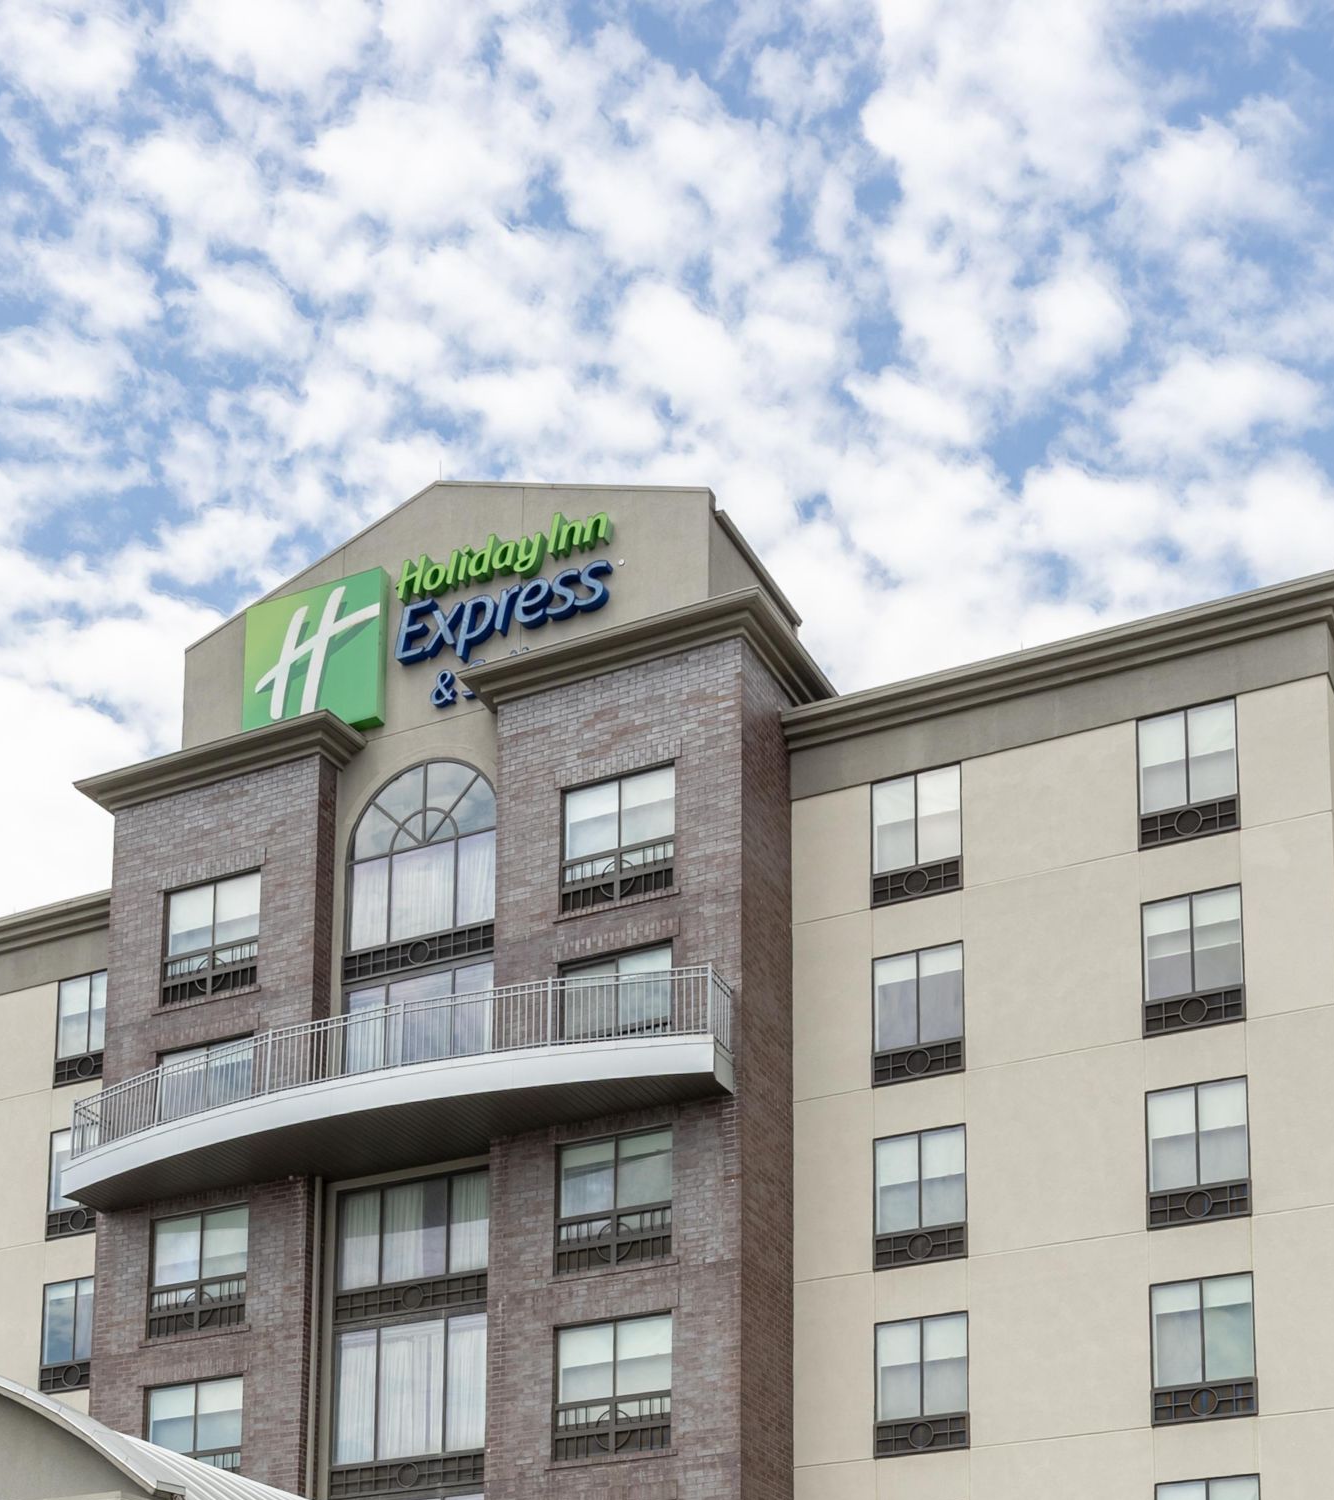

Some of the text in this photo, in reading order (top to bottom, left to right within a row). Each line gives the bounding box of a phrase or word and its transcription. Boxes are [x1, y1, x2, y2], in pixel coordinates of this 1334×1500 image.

[396, 512, 612, 604] Holiday Inn
[394, 560, 613, 666] Express
[430, 669, 458, 708] &
